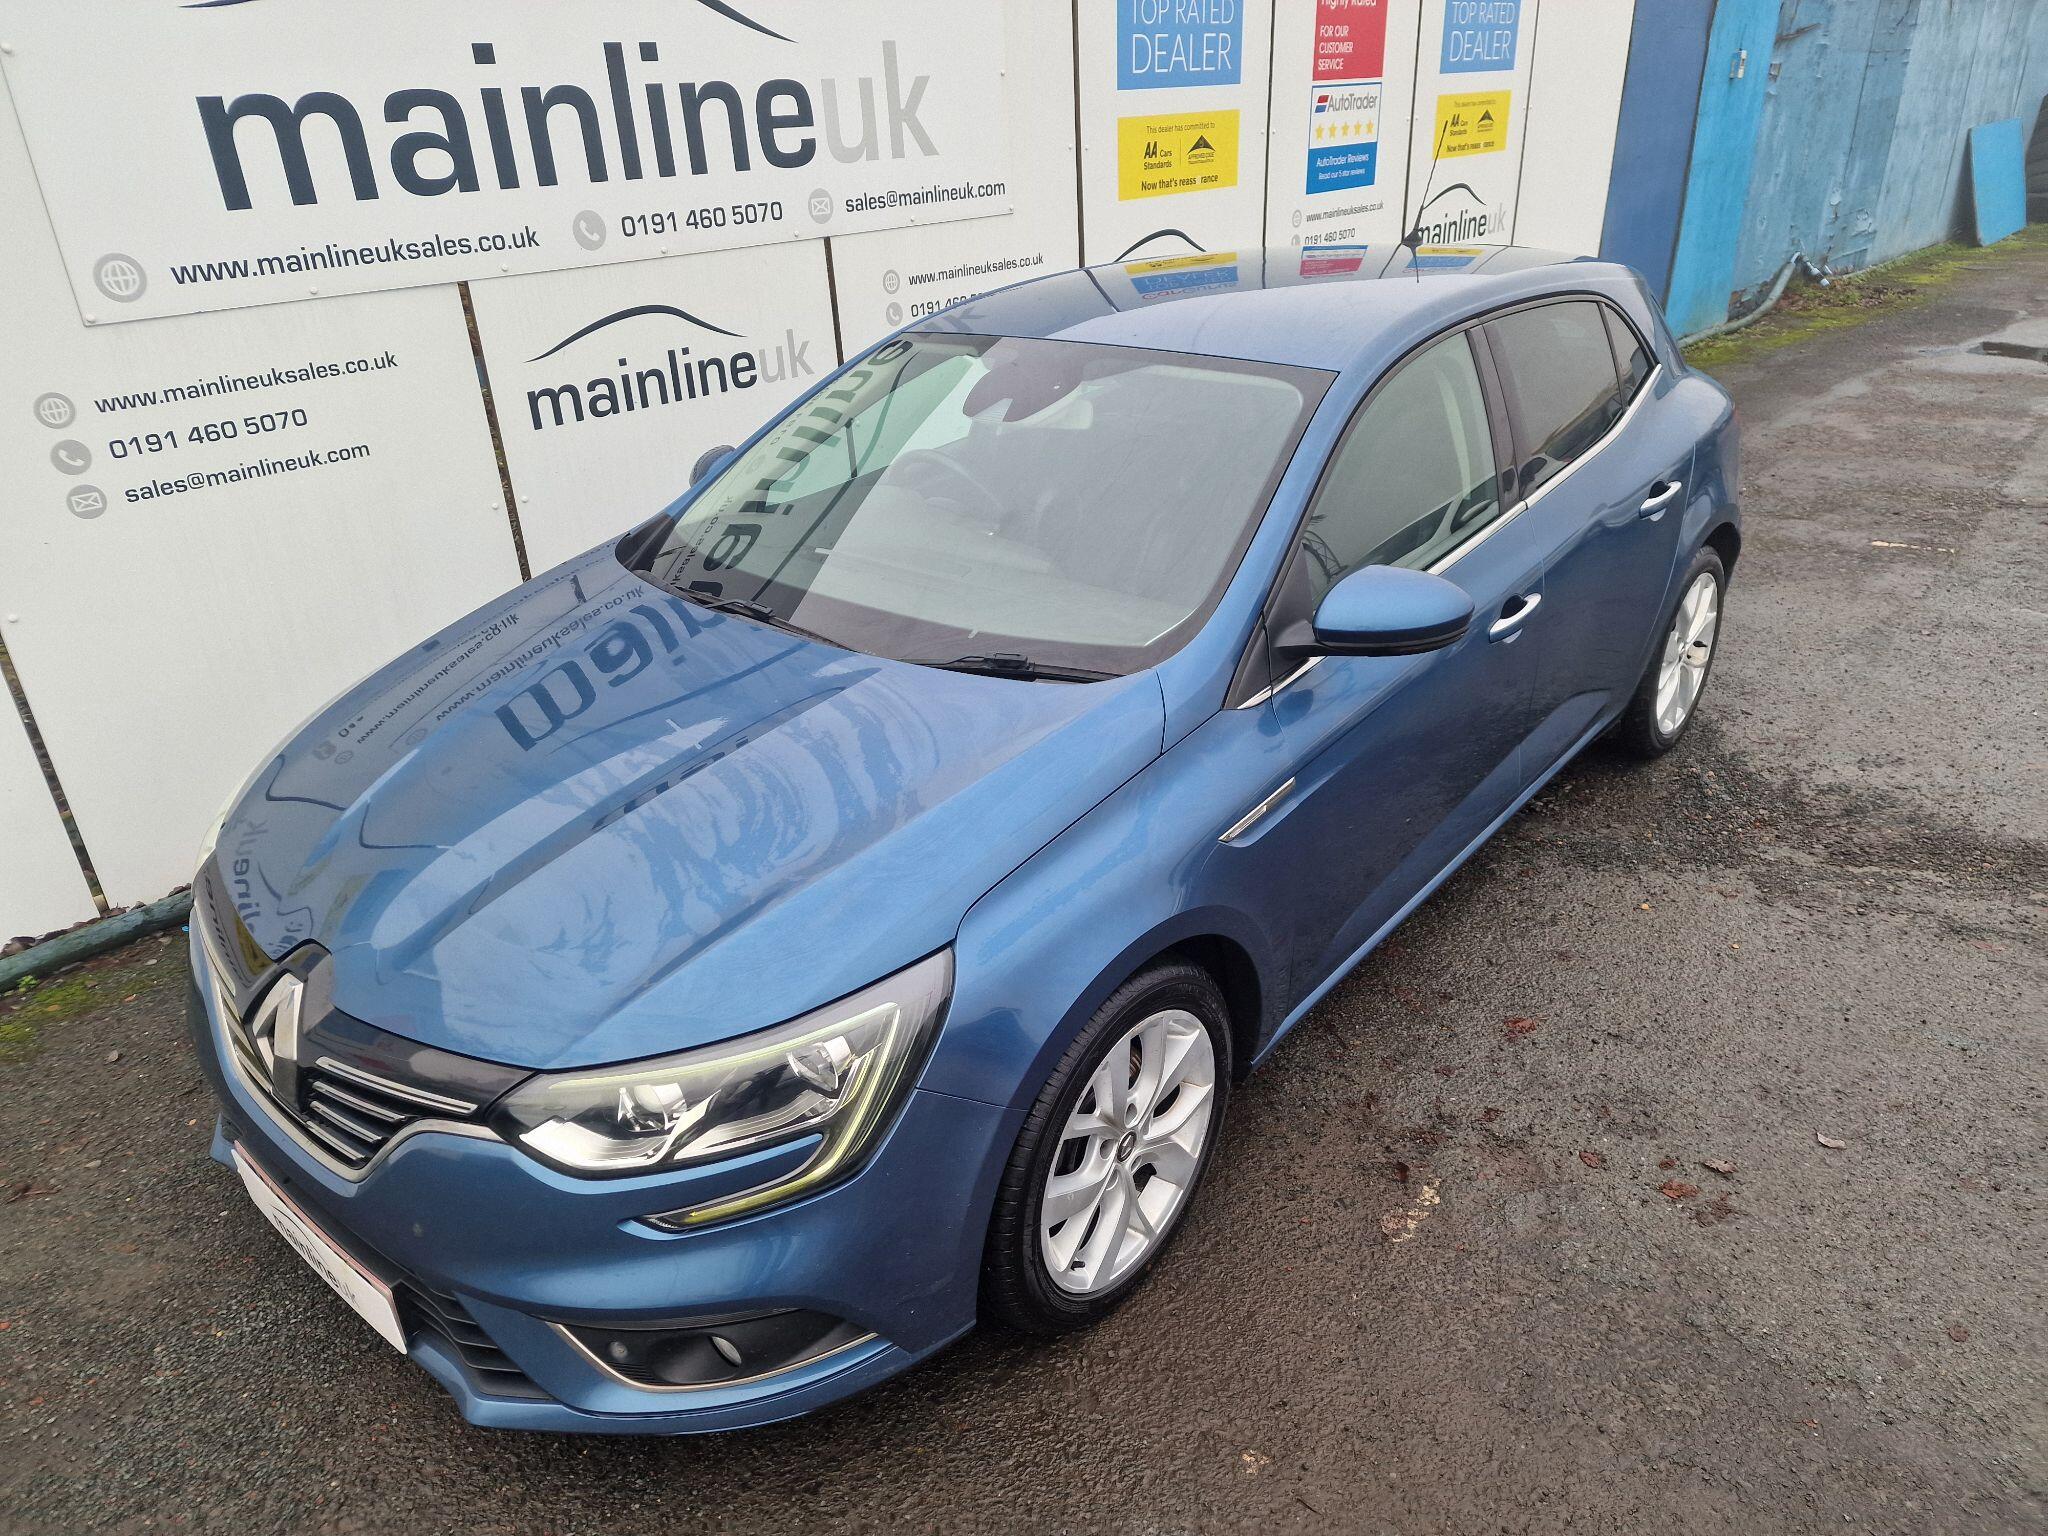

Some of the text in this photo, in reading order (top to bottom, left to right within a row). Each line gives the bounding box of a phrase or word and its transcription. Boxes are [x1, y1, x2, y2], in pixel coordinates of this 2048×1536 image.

[1133, 0, 1235, 24] TOP RATED
[1452, 1, 1516, 24] TOP RATED
[1319, 25, 1349, 37] FOR OUR
[1132, 32, 1232, 74] DEALER
[1319, 41, 1354, 53] CUSTOMER
[1449, 30, 1512, 61] DEALER
[1318, 58, 1344, 70] SERVICE
[1327, 92, 1378, 112] AutoTrader
[195, 40, 939, 211] mainlineuk
[1146, 125, 1157, 134] This
[1158, 124, 1174, 133] dealer
[1174, 123, 1184, 132] has
[1184, 122, 1209, 131] committed
[1143, 140, 1173, 160] AA Cars
[1347, 153, 1370, 163] Reviews
[1143, 159, 1173, 170] Standards
[1141, 181, 1158, 191] Now
[1158, 177, 1178, 189] that's
[845, 180, 1006, 213] sales@mainlineuk.com
[621, 201, 784, 239] 0191 460 5070
[1305, 200, 1384, 222] www.mainlineuksales.co.uk
[1304, 228, 1356, 245] 0191 460 5070
[170, 226, 541, 286] www.mainlineuksales.co.uk
[908, 252, 1044, 286] www.mainlineuksales.co.uk
[911, 300, 941, 317] 0191
[94, 350, 398, 414] www.mainlineuksales.co.uk
[526, 328, 814, 431] mainlineuk
[108, 408, 308, 460] 0191 460 5070
[124, 441, 371, 504] sales@mainlineuk.com
